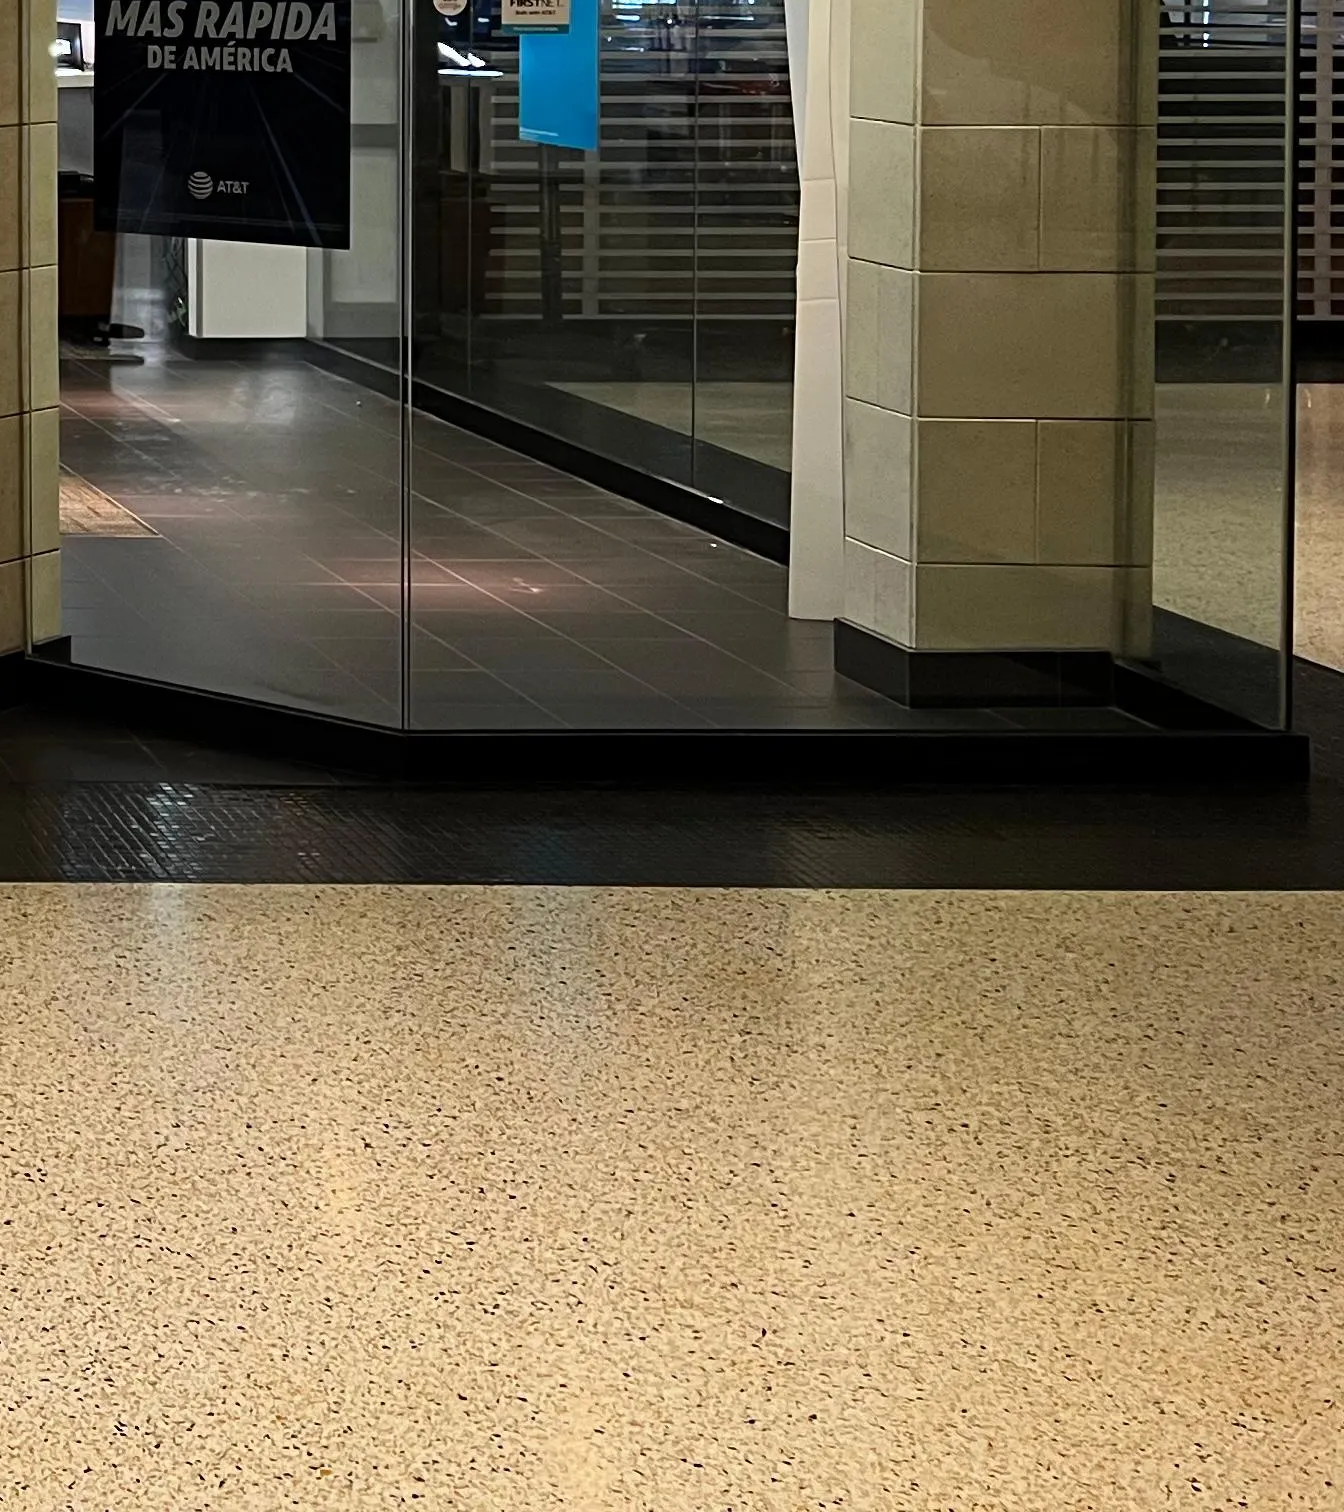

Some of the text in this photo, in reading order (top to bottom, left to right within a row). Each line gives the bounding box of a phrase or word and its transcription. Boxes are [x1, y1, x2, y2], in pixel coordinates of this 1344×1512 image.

[147, 41, 294, 73] DE AMÉRICA
[217, 180, 249, 194] AT&T
